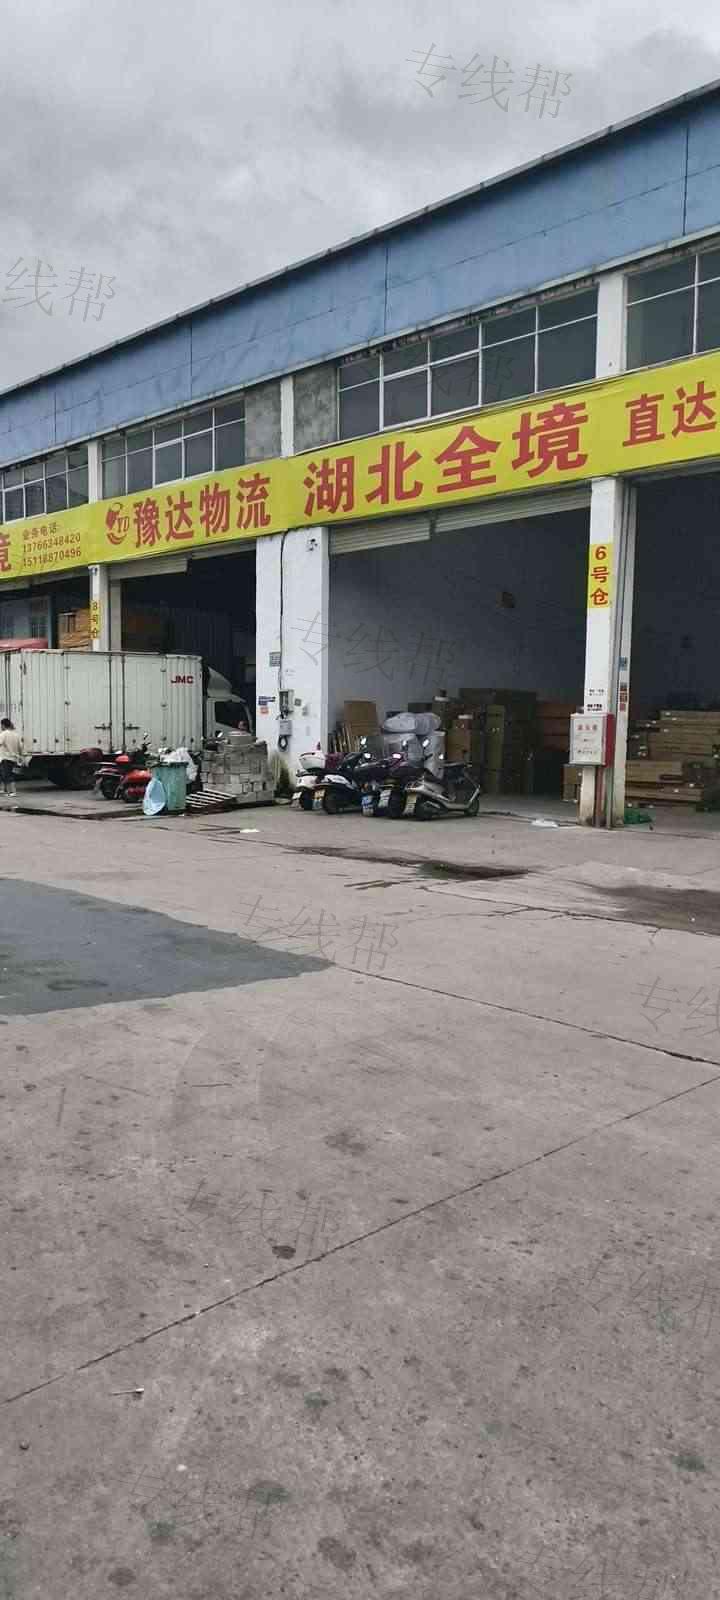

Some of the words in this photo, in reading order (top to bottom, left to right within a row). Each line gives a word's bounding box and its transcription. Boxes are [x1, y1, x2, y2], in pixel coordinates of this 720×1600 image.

[133, 472, 272, 548] 豫达物流
[303, 401, 588, 517] 湖北全境
[622, 381, 717, 447] 直达
[591, 546, 609, 605] 6号仓
[171, 675, 193, 684] JMC
